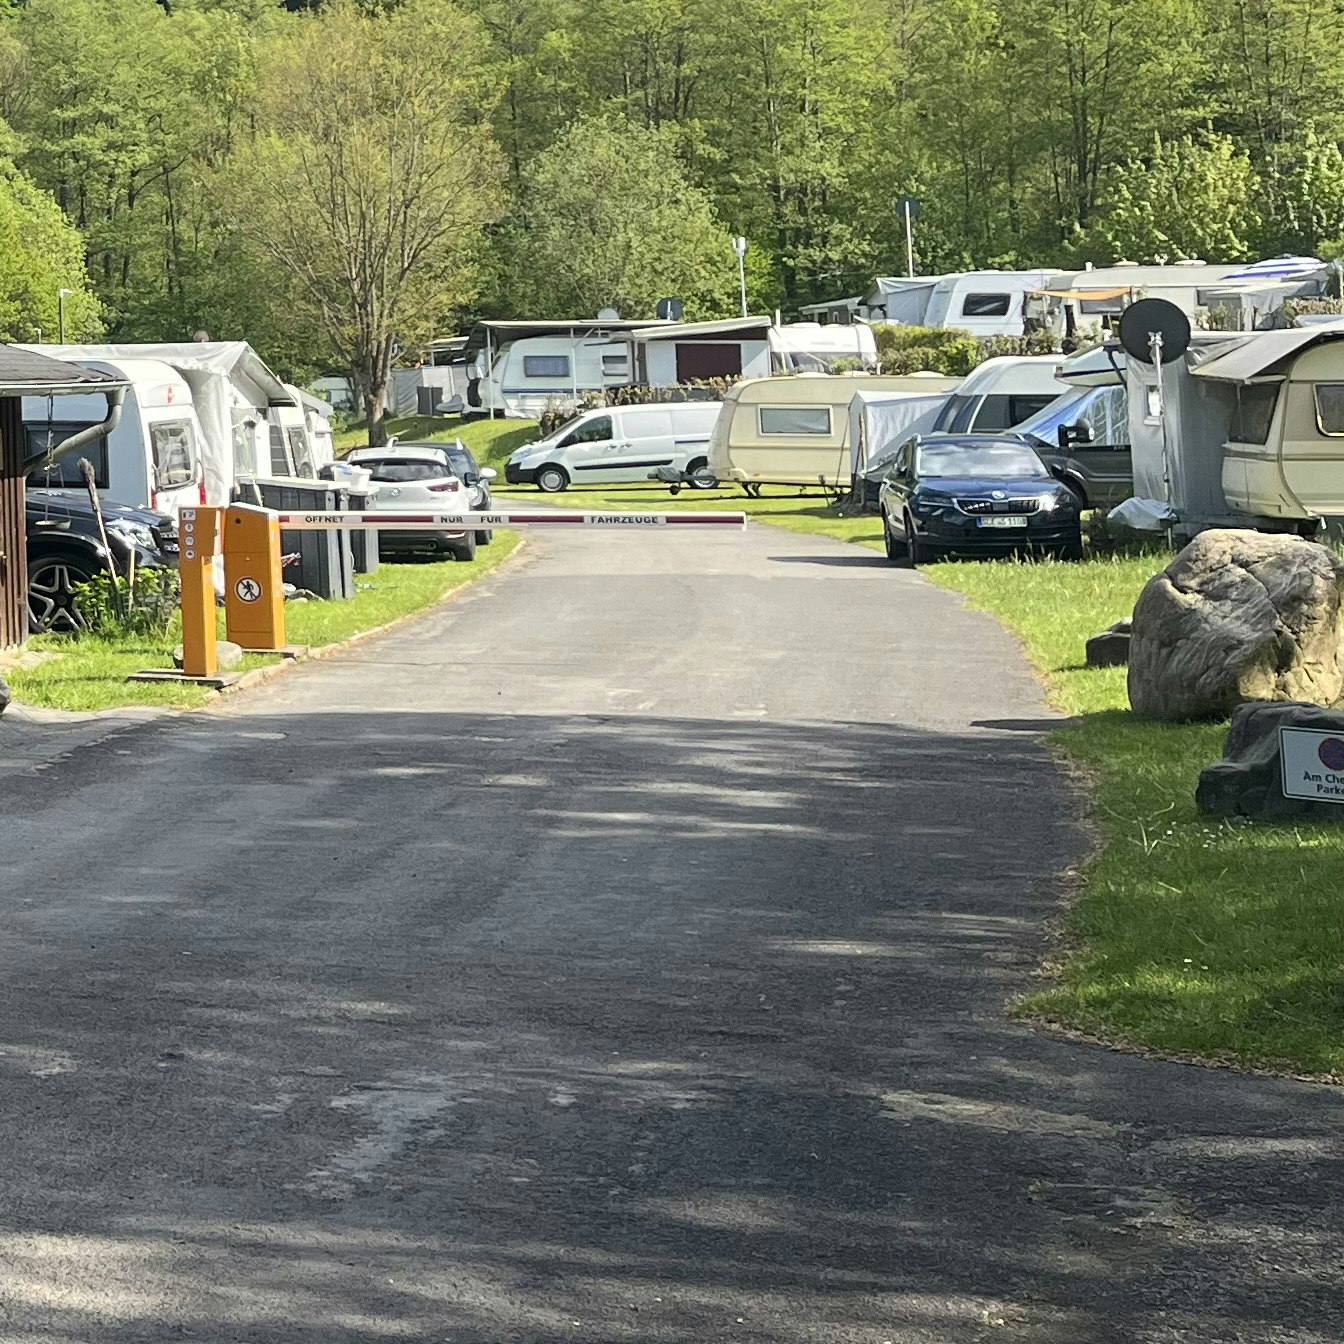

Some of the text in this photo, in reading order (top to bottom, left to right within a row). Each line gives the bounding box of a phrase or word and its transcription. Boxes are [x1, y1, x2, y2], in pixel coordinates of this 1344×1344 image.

[440, 515, 464, 524] NUR
[590, 516, 659, 524] FAHRZEUGE
[1303, 770, 1322, 782] Am
